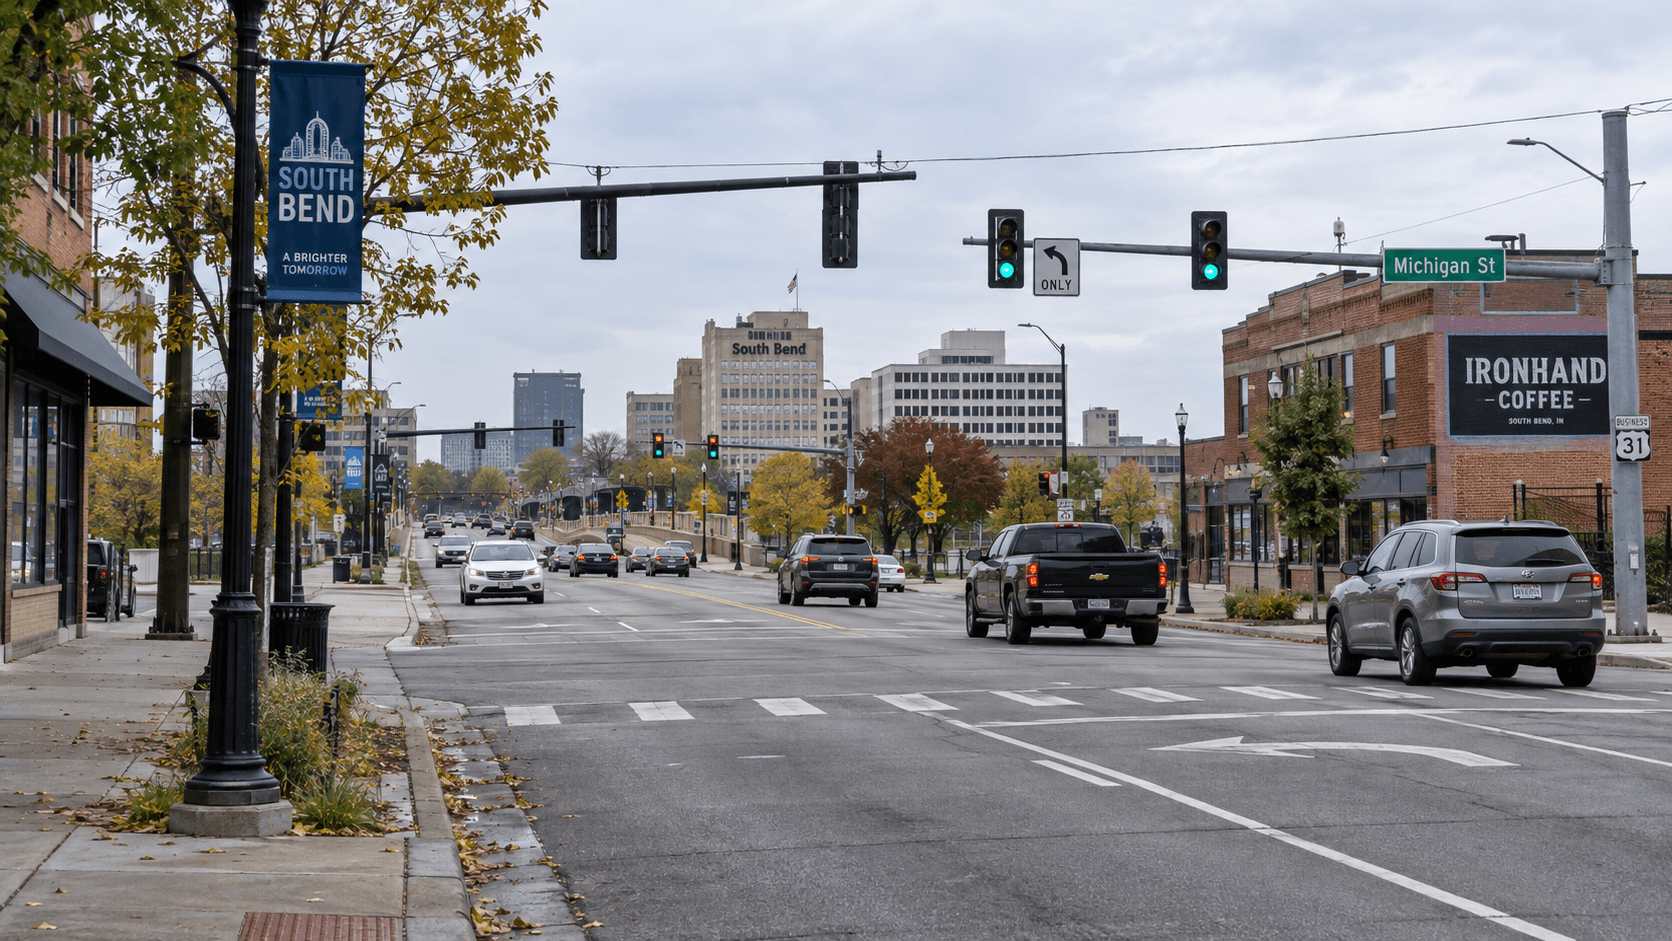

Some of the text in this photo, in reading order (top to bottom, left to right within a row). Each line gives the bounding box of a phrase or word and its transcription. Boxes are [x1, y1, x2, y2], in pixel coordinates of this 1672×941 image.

[279, 166, 354, 191] SOUTH
[279, 193, 354, 223] BEND
[282, 252, 348, 263] A BRIGHTER
[282, 264, 348, 275] TOMORROW
[1394, 257, 1496, 278] Michigan St
[1041, 279, 1072, 290] ONLY
[732, 343, 806, 355] South Bend
[1465, 357, 1607, 384] IRONHAND
[1498, 390, 1574, 409] COFFEE
[1508, 417, 1532, 425] SOUTH
[1616, 418, 1648, 427] BUSINESS
[1623, 437, 1643, 454] 31
